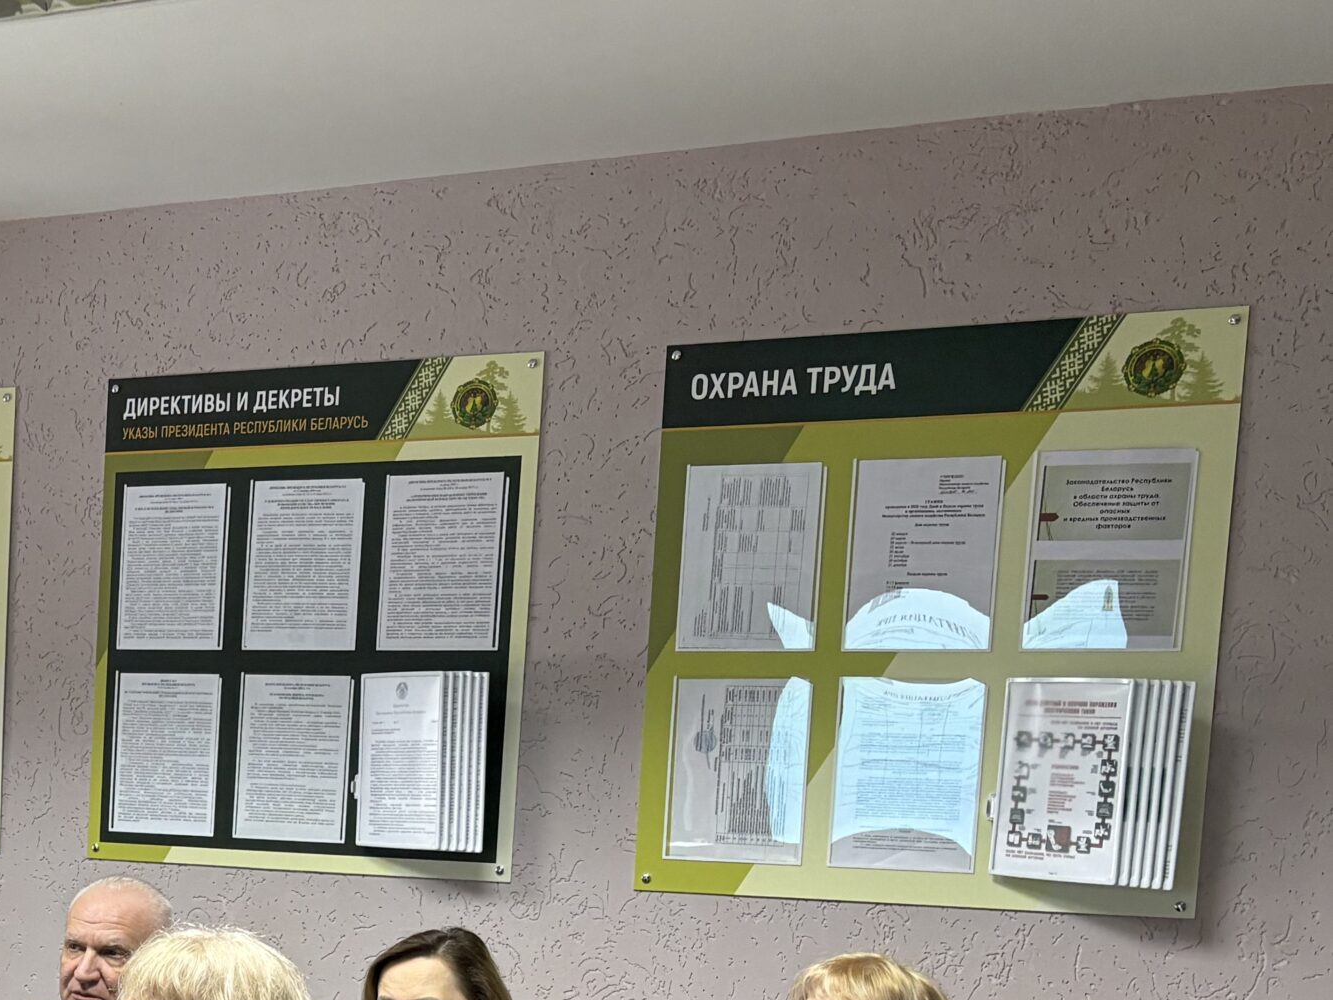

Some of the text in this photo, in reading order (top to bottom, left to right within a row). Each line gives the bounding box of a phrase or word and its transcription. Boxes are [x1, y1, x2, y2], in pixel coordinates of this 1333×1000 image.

[691, 362, 897, 400] ОХРАНА ТРУДА
[123, 386, 341, 420] ДИРЕКТИВЫ И ДЕКРЕТЫ
[122, 415, 369, 440] УКАЗЫ ПРЕЗИДЕНТА РЕСПУБЛИКИ БЕЛАРУСЬ
